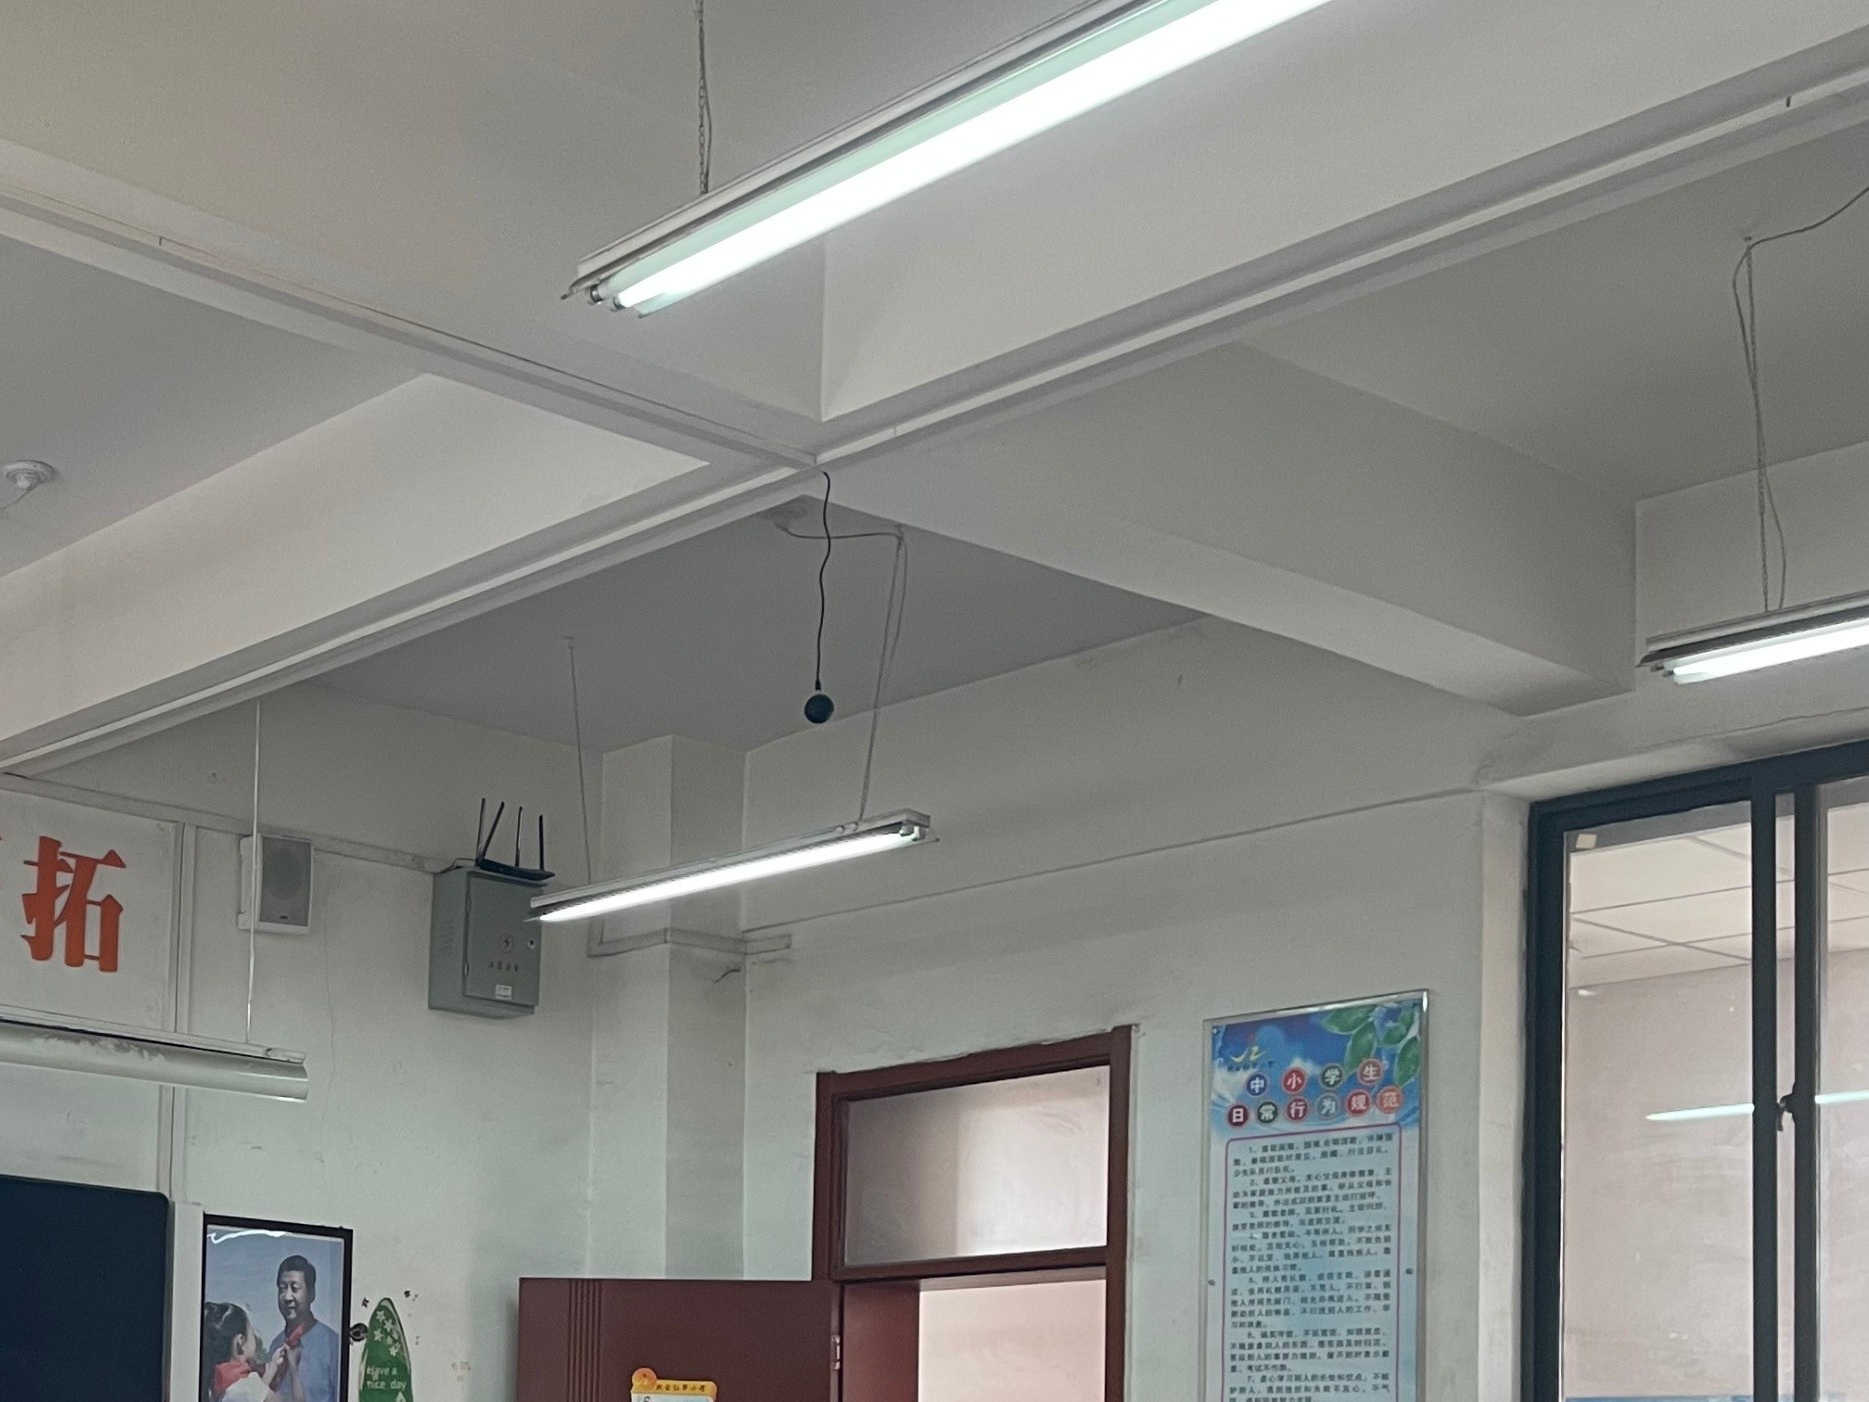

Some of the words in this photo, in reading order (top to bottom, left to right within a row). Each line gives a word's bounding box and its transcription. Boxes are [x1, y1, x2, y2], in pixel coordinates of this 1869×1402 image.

[1249, 1064, 1380, 1094] 中小学生
[1232, 1091, 1400, 1123] 日常行为规范
